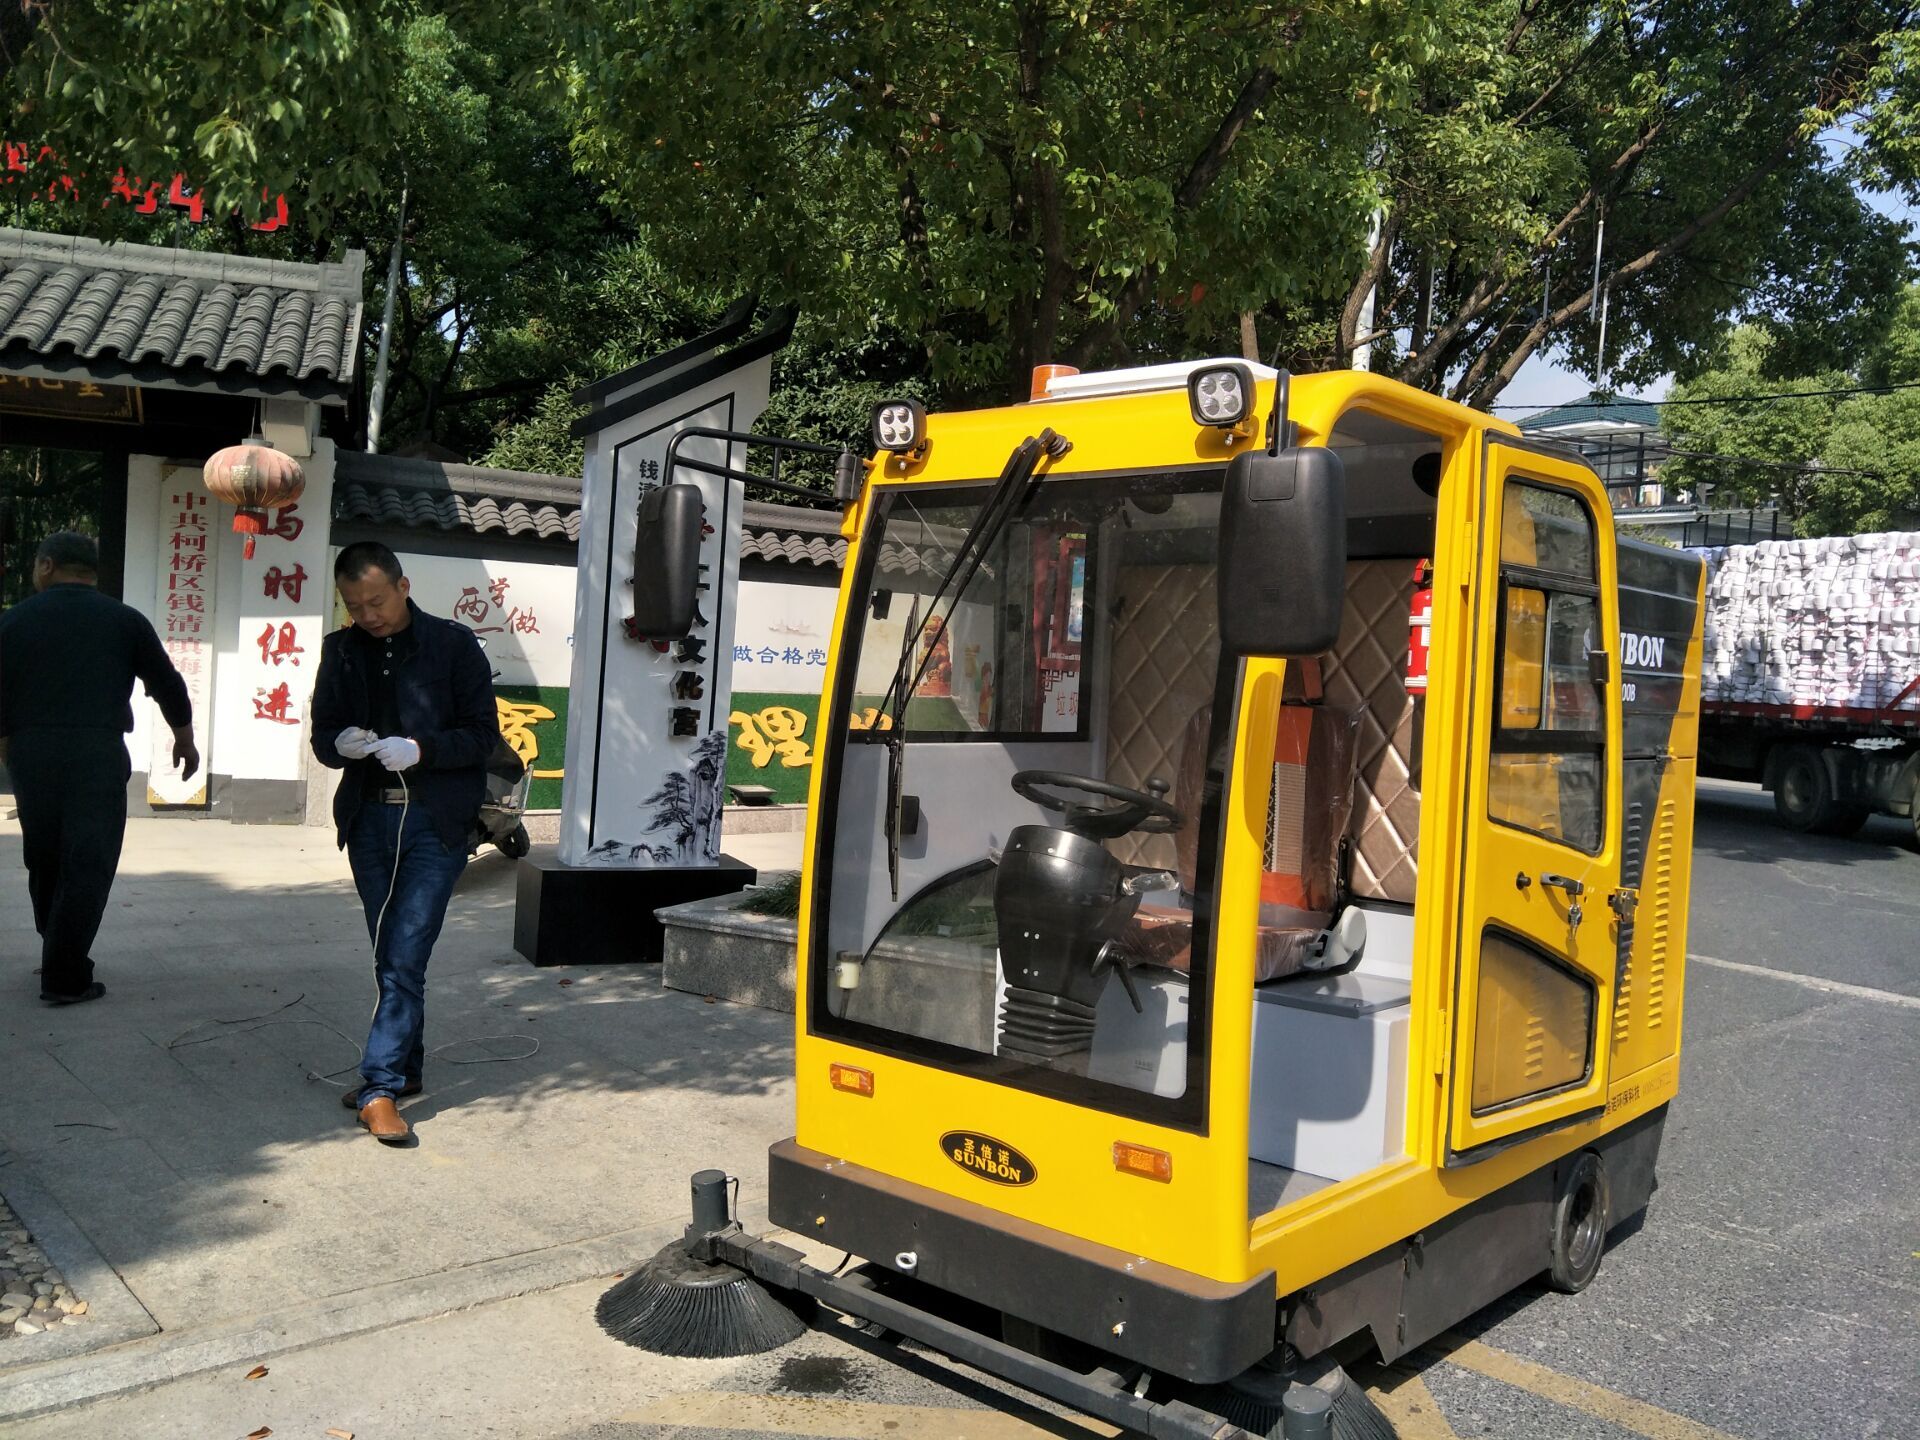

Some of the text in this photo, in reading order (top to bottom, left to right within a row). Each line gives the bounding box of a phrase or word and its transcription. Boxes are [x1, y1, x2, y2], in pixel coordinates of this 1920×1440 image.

[253, 503, 308, 725] 与时俱进
[453, 577, 541, 635] 两学一做
[954, 1149, 1021, 1182] SUNBON
